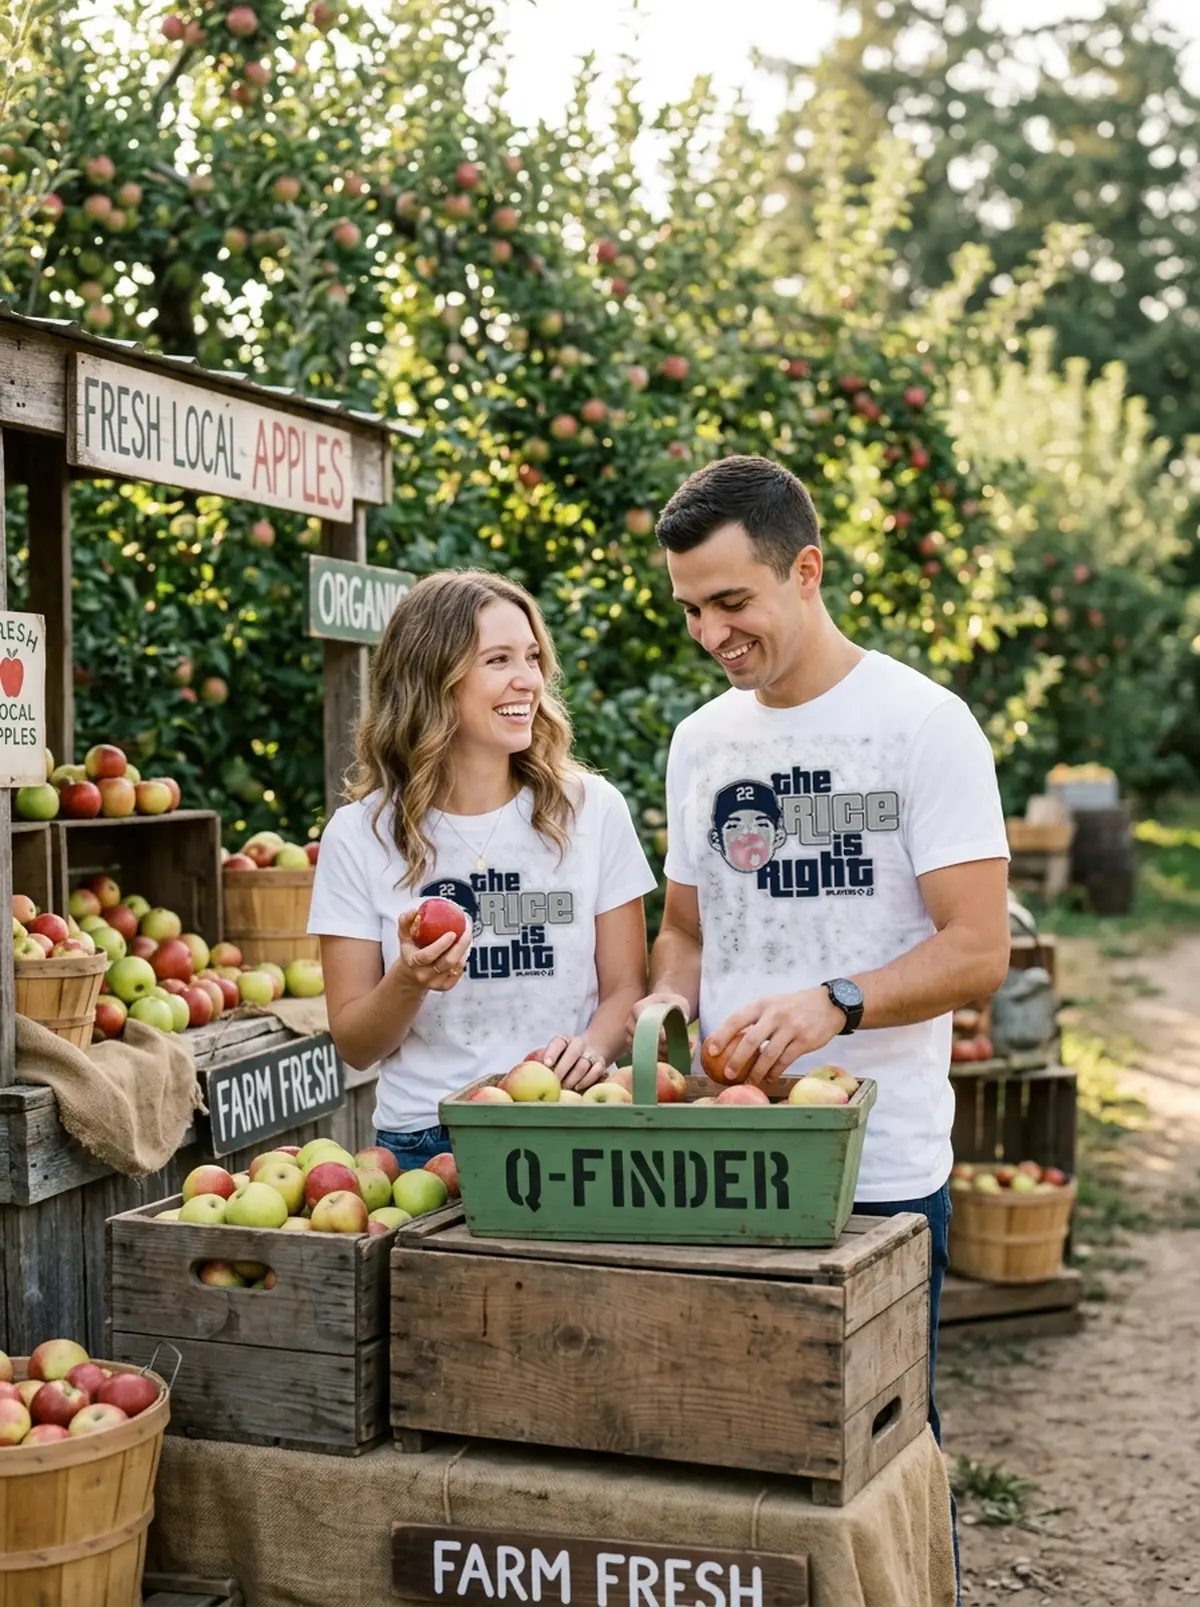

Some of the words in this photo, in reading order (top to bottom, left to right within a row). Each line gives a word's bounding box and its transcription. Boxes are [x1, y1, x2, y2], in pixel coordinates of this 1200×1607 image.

[84, 376, 161, 463] FRESH
[172, 401, 241, 481] LOCAL
[252, 419, 345, 510] APPLES
[0, 620, 38, 653] RESH
[0, 703, 35, 721] OCAL
[0, 727, 37, 746] PLES
[771, 766, 831, 794] the
[736, 786, 755, 801] 22
[833, 834, 862, 856] is
[439, 883, 456, 897] 22
[469, 868, 520, 892] the
[521, 925, 545, 944] is
[216, 1065, 276, 1142] FARM
[278, 1044, 340, 1118] FRESH
[506, 1148, 790, 1212] Q-FINDER
[434, 1540, 571, 1604] FARM
[597, 1553, 763, 1607] FRESH
